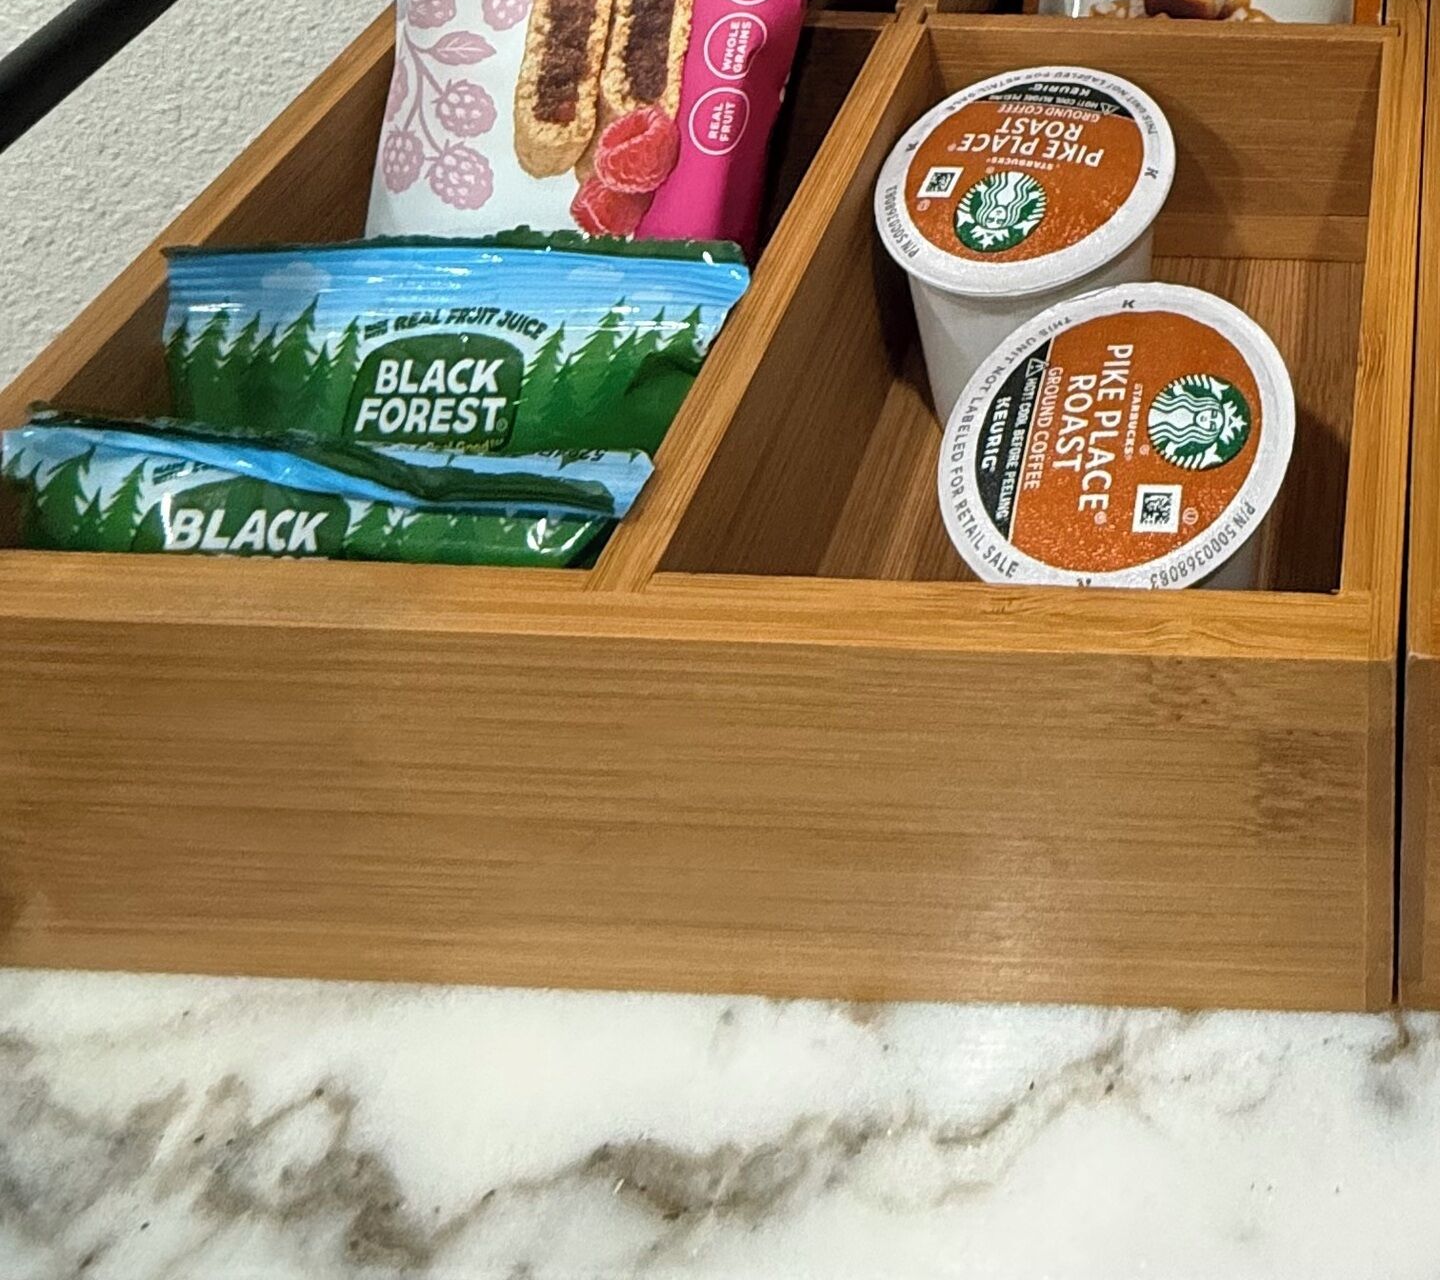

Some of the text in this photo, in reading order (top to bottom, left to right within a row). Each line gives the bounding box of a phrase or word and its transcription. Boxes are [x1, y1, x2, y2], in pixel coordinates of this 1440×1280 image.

[720, 20, 741, 72] WHOLE
[732, 20, 753, 74] GRAINS
[1032, 83, 1091, 97] KEURIG
[707, 102, 725, 141] REAL
[719, 101, 737, 142] FRUIT
[996, 103, 1101, 123] GROUND COFFEE
[996, 117, 1084, 141] ROAST
[957, 132, 1105, 168] PIKE PLACE
[394, 308, 442, 331] REAL
[444, 306, 500, 325] FRUIT
[496, 310, 549, 340] JUICE
[374, 358, 505, 395] BLACK
[983, 365, 1006, 392] NOT
[353, 396, 507, 434] FOREST
[950, 396, 985, 463] LABELED
[980, 396, 1012, 471] KEURIG
[1023, 366, 1064, 490] GROUND COFFEE
[1052, 373, 1098, 473] ROAST
[1077, 344, 1134, 513] PIKE PLACE
[1123, 382, 1144, 457] STARBUCKS
[949, 465, 966, 496] FOR
[163, 509, 330, 552] BLACK
[953, 499, 981, 552] RETAIL
[982, 545, 1021, 579] SALE
